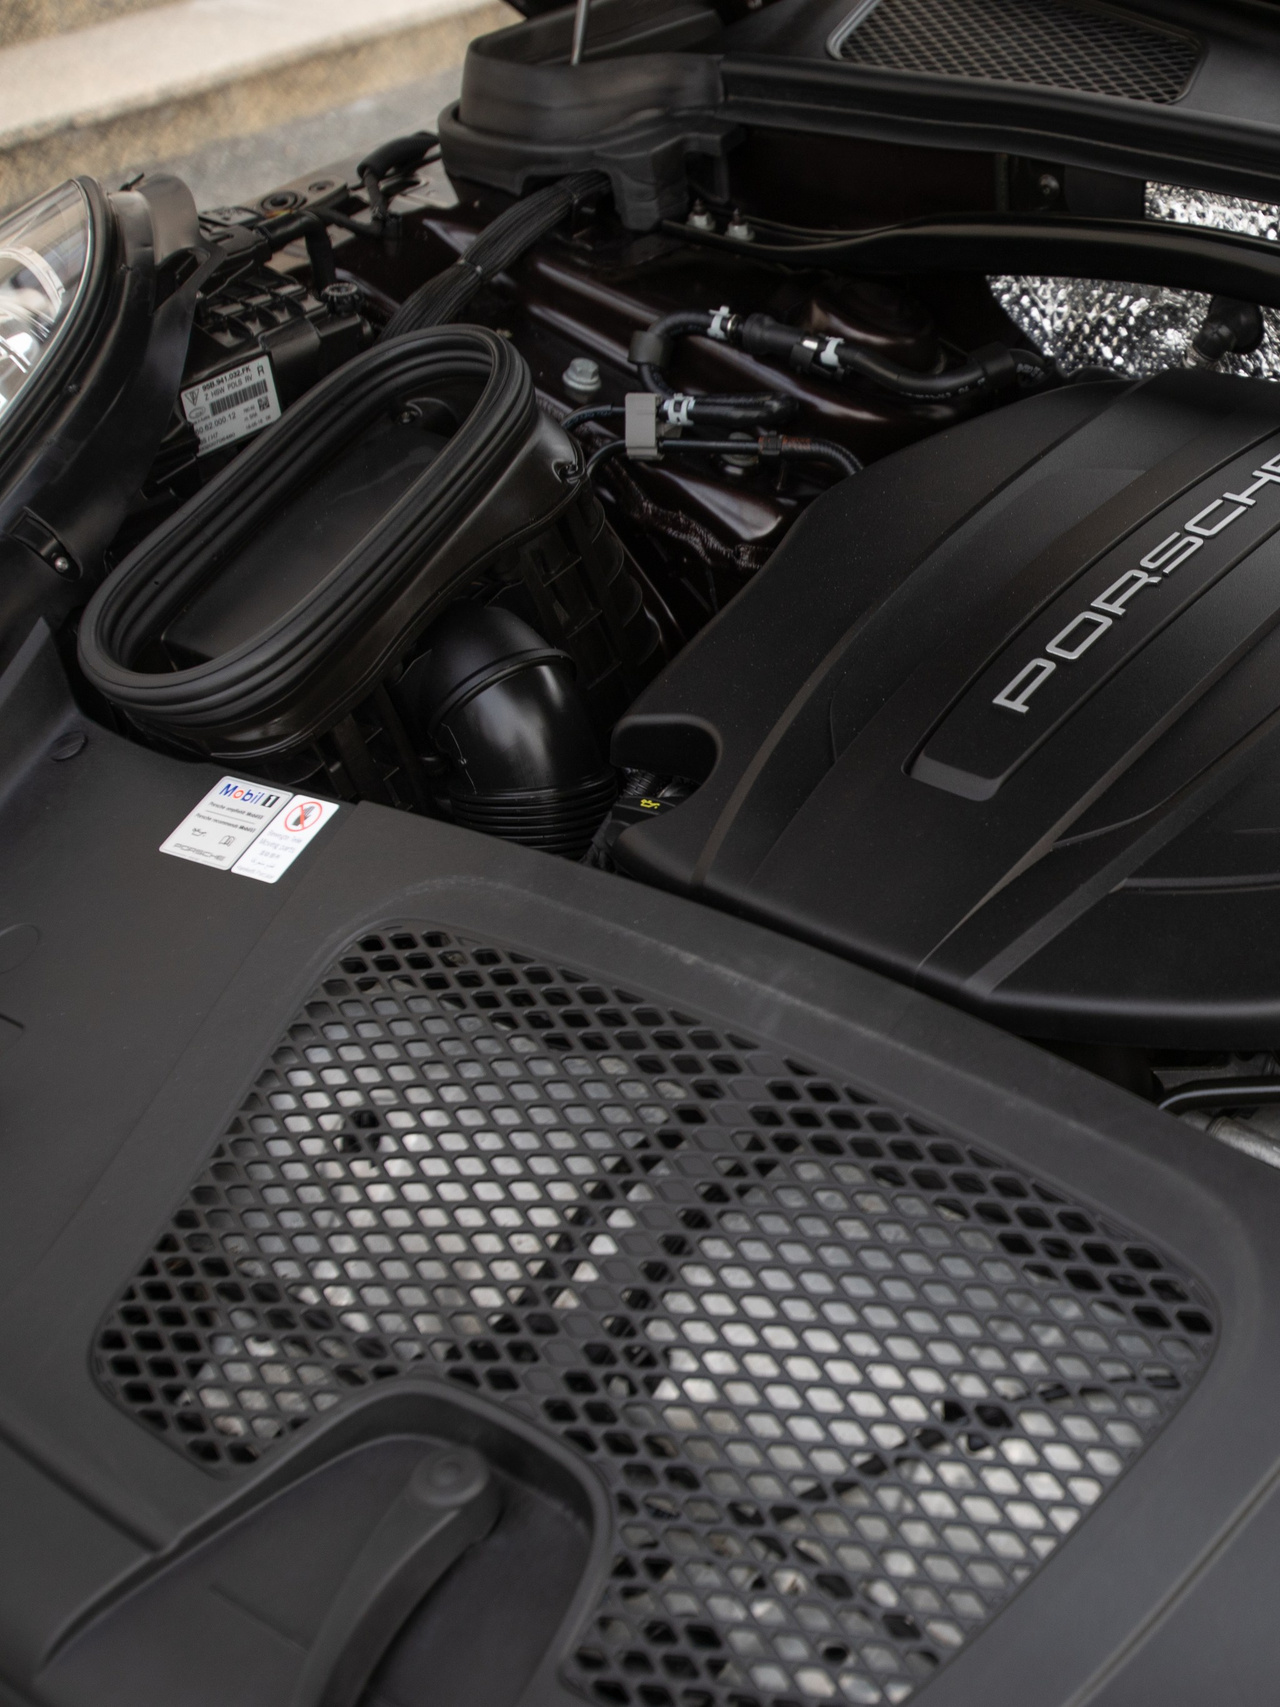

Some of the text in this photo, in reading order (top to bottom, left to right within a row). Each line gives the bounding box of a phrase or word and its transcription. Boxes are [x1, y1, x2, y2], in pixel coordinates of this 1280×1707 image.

[257, 365, 265, 376] R
[219, 783, 265, 805] Mobil
[173, 843, 226, 862] PORSCHE
